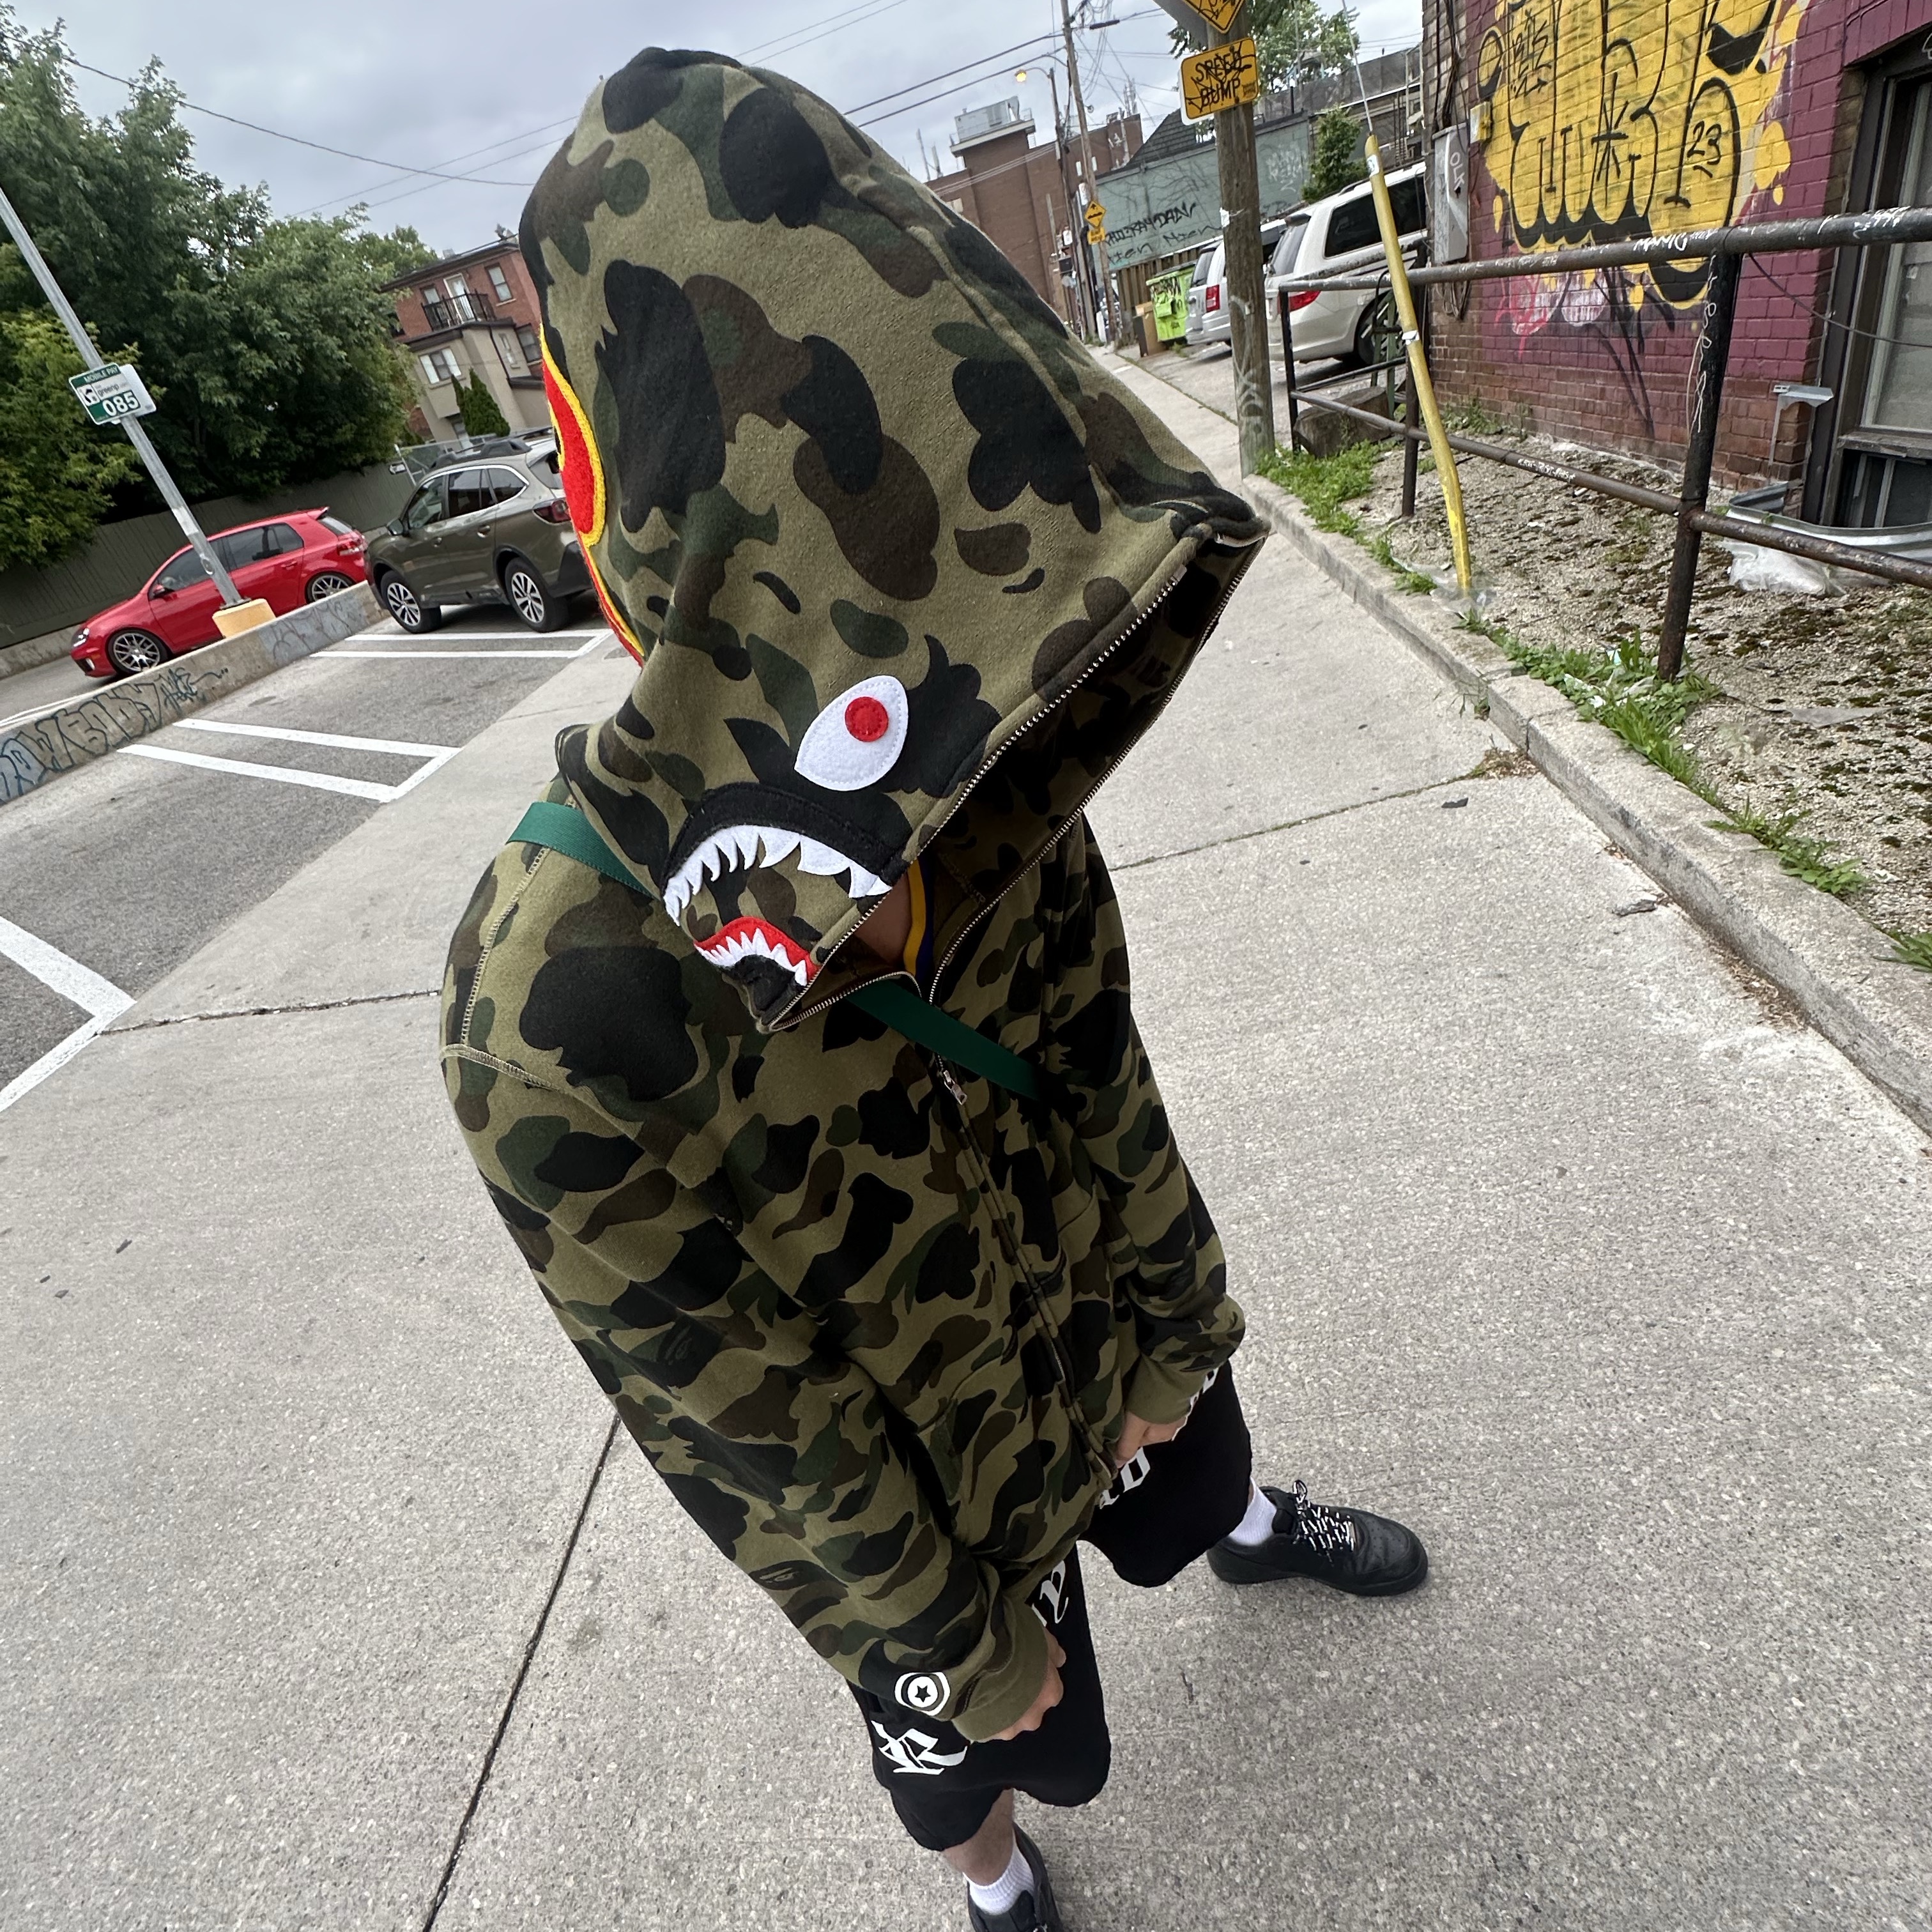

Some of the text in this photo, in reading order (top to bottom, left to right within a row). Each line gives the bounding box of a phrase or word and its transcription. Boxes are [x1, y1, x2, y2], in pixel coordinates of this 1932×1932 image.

[1200, 78, 1241, 107] BUMP
[107, 367, 118, 376] PAY
[102, 390, 139, 417] 085
